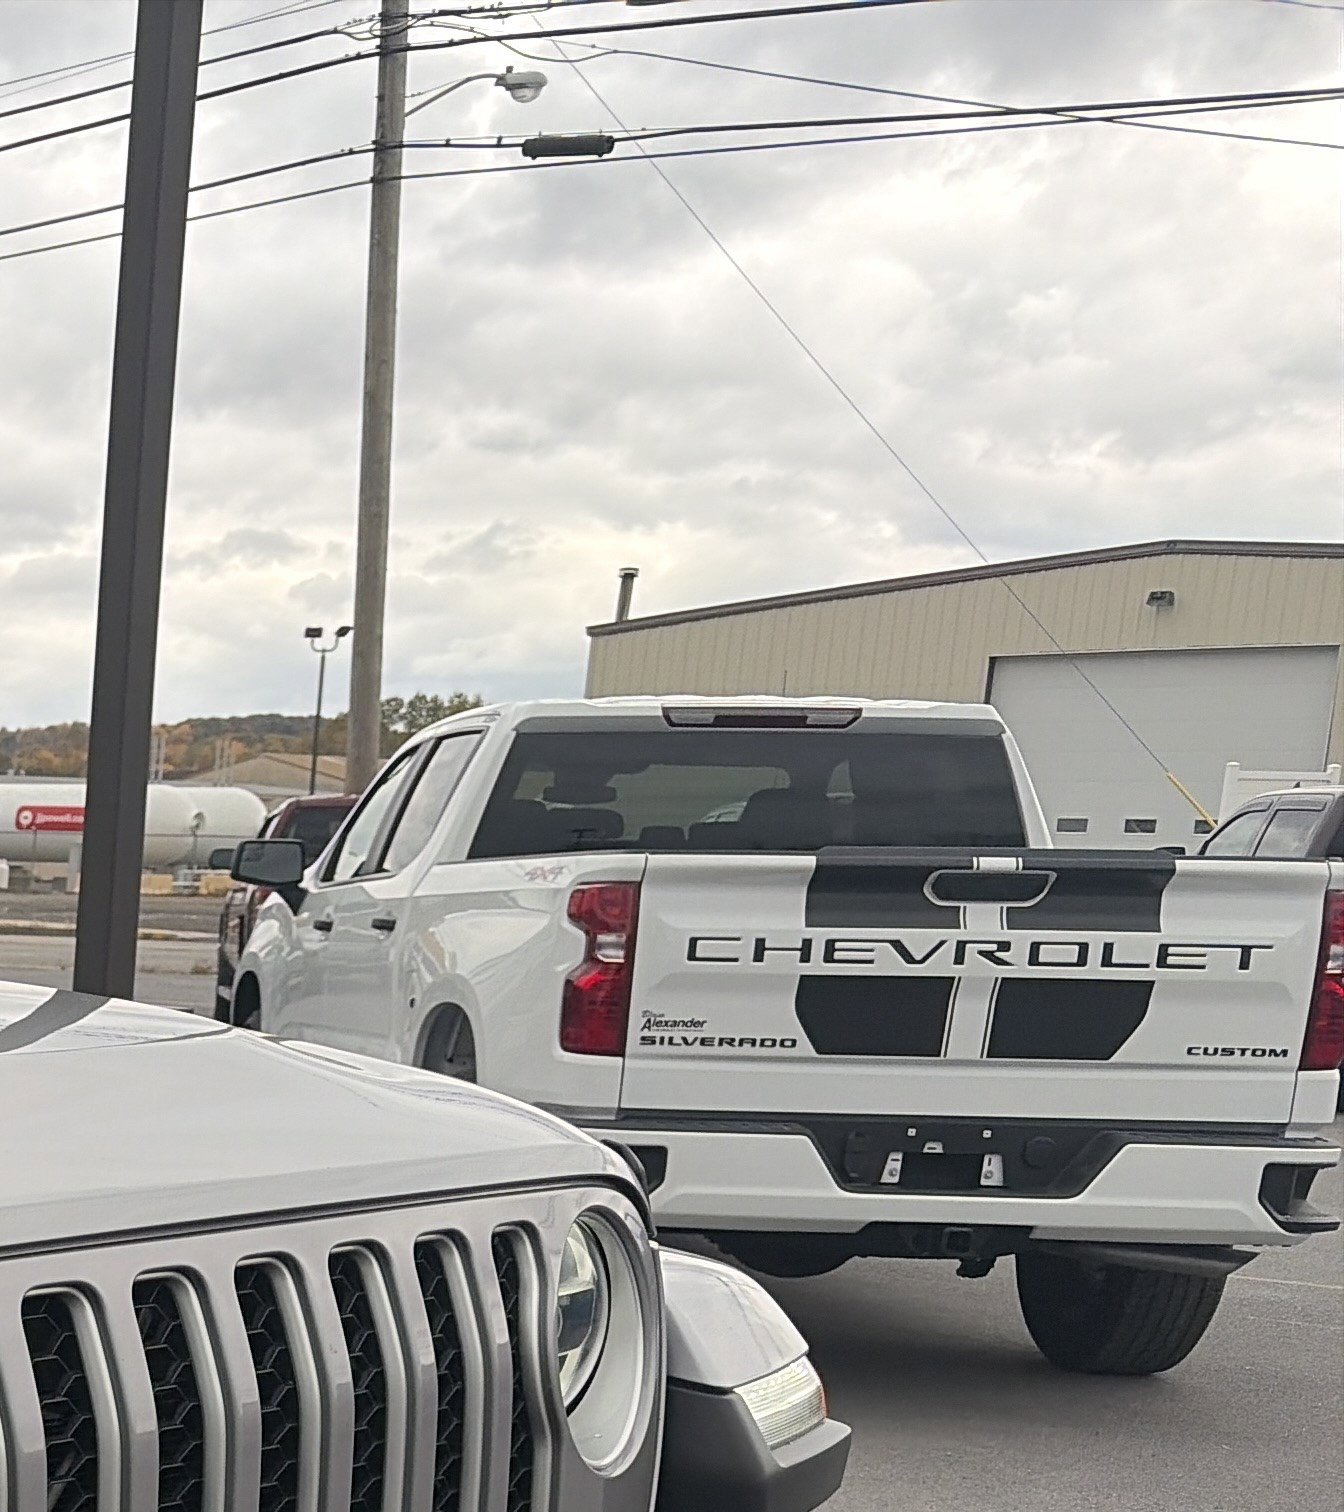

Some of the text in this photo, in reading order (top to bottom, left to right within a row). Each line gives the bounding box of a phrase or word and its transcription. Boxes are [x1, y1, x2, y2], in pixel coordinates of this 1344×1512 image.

[686, 935, 1275, 973] CHEVROLET
[640, 1017, 708, 1032] Alexander
[639, 1035, 797, 1049] SILVERADO
[1186, 1045, 1290, 1060] CUSTOM
